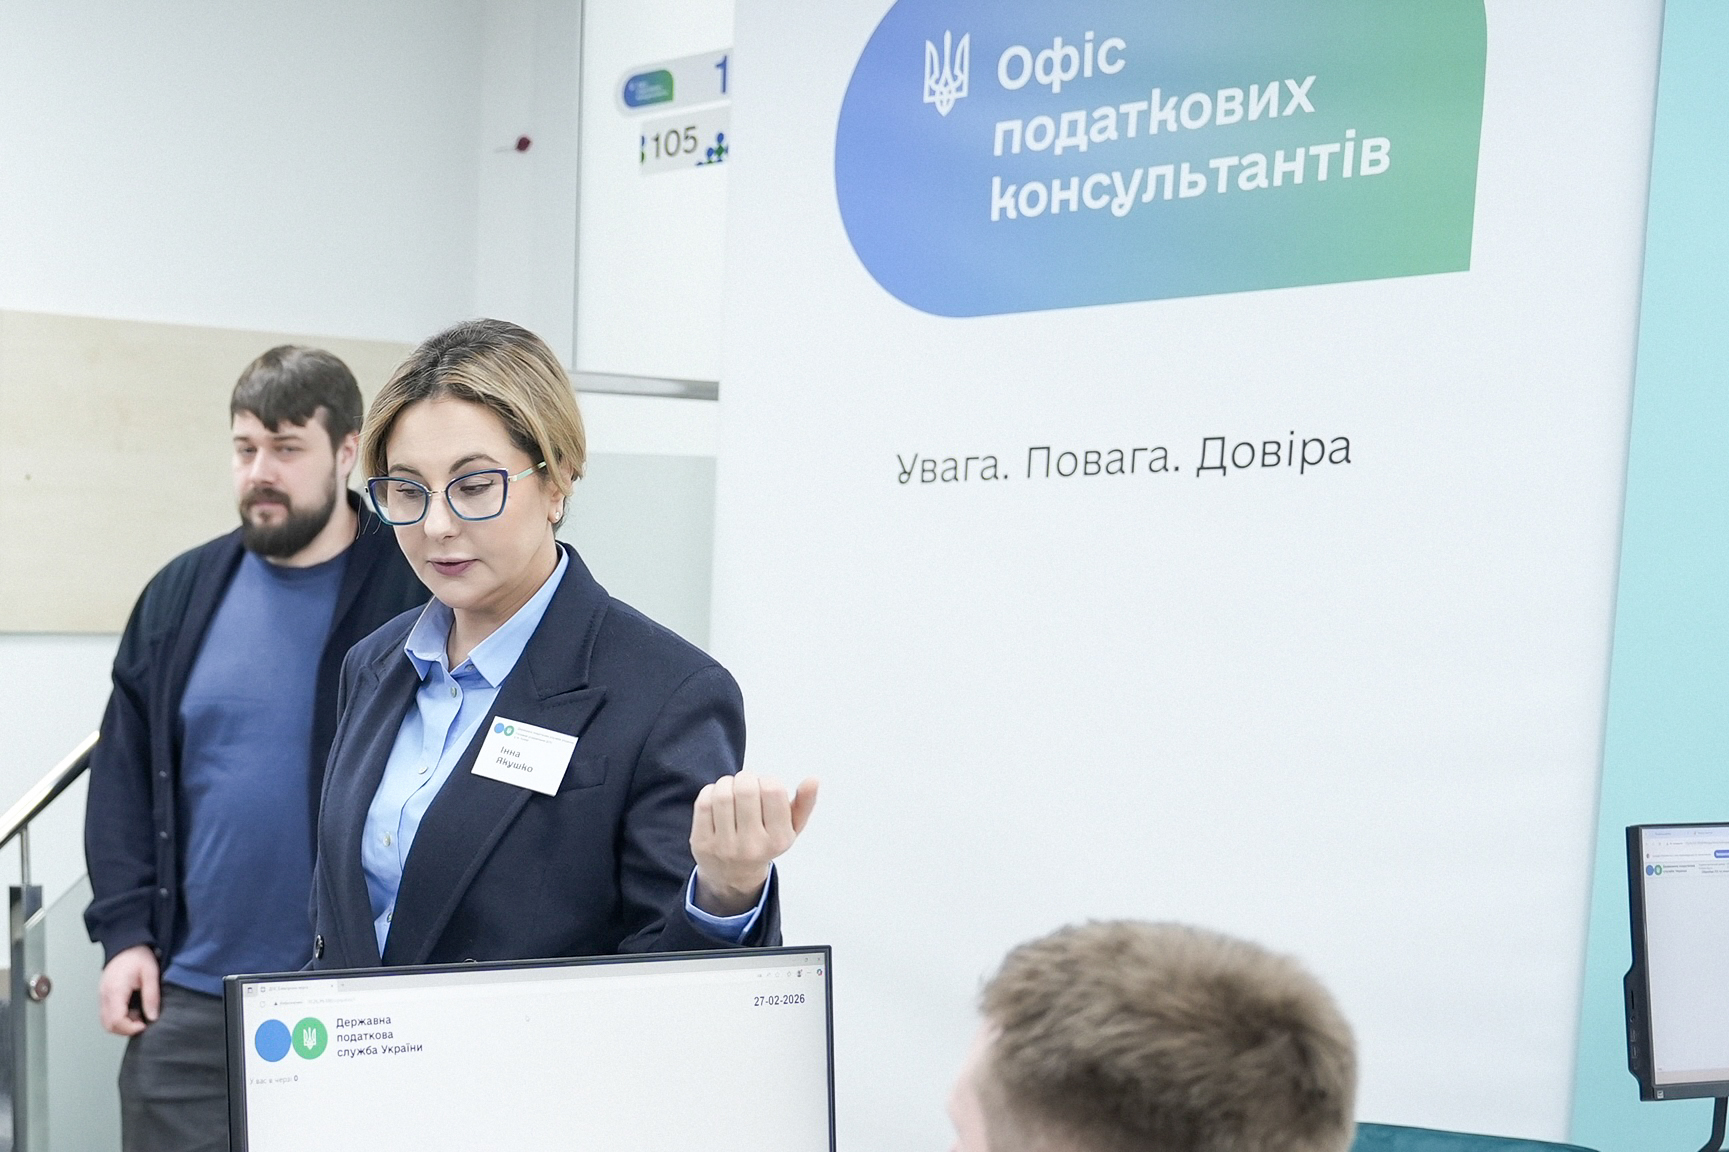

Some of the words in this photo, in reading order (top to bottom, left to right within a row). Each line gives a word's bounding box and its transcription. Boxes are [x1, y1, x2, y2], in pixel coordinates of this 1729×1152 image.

[997, 31, 1127, 93] Офіс
[993, 75, 1317, 156] податкових
[651, 126, 698, 158] 105
[990, 129, 1392, 222] консультантів
[896, 452, 1009, 485] Увага.
[1026, 445, 1180, 480] Повага.
[1196, 430, 1352, 478] Довіра
[500, 746, 521, 758] Інна
[495, 756, 534, 773] Якушко
[753, 993, 806, 1007] 27-02-2026
[336, 1015, 392, 1029] Державна
[336, 1030, 394, 1043] податкова
[337, 1044, 379, 1059] служба
[381, 1042, 423, 1056] України
